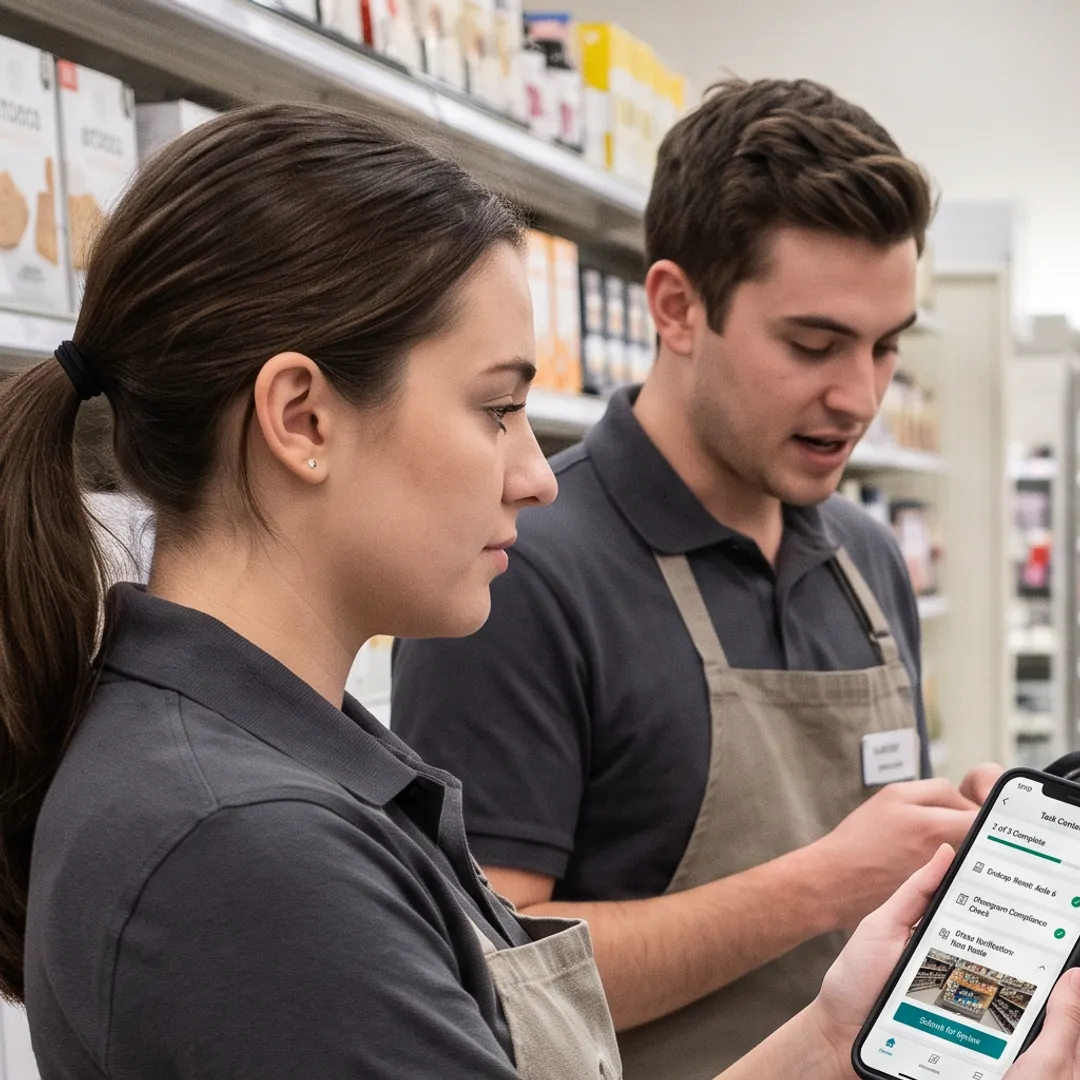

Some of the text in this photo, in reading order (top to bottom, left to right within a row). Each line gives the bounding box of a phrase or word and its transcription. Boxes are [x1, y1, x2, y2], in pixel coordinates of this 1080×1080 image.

[992, 823, 998, 831] 2
[998, 824, 1007, 833] of
[1012, 829, 1047, 847] Complete
